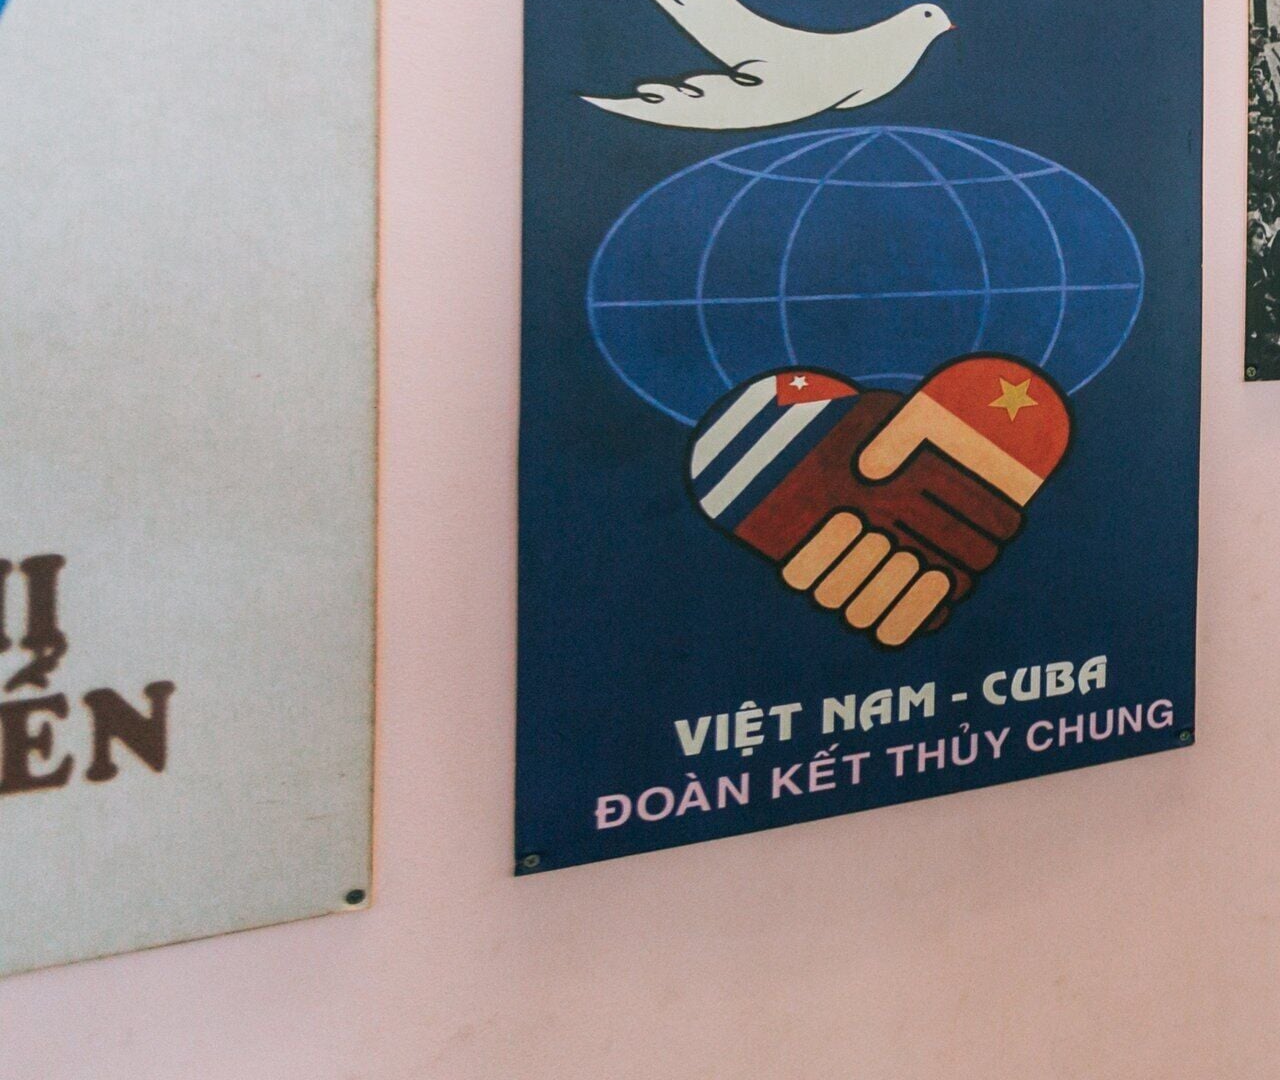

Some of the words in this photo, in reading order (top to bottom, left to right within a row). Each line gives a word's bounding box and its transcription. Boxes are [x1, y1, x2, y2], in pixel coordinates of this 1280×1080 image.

[594, 772, 751, 831] ĐOÀN
[771, 742, 872, 801] KẾT
[886, 722, 1014, 779] THỦY
[1025, 697, 1176, 753] CHUNG
[673, 700, 803, 758] VIỆT
[820, 682, 936, 736] NAM
[981, 654, 1109, 708] CUBA
